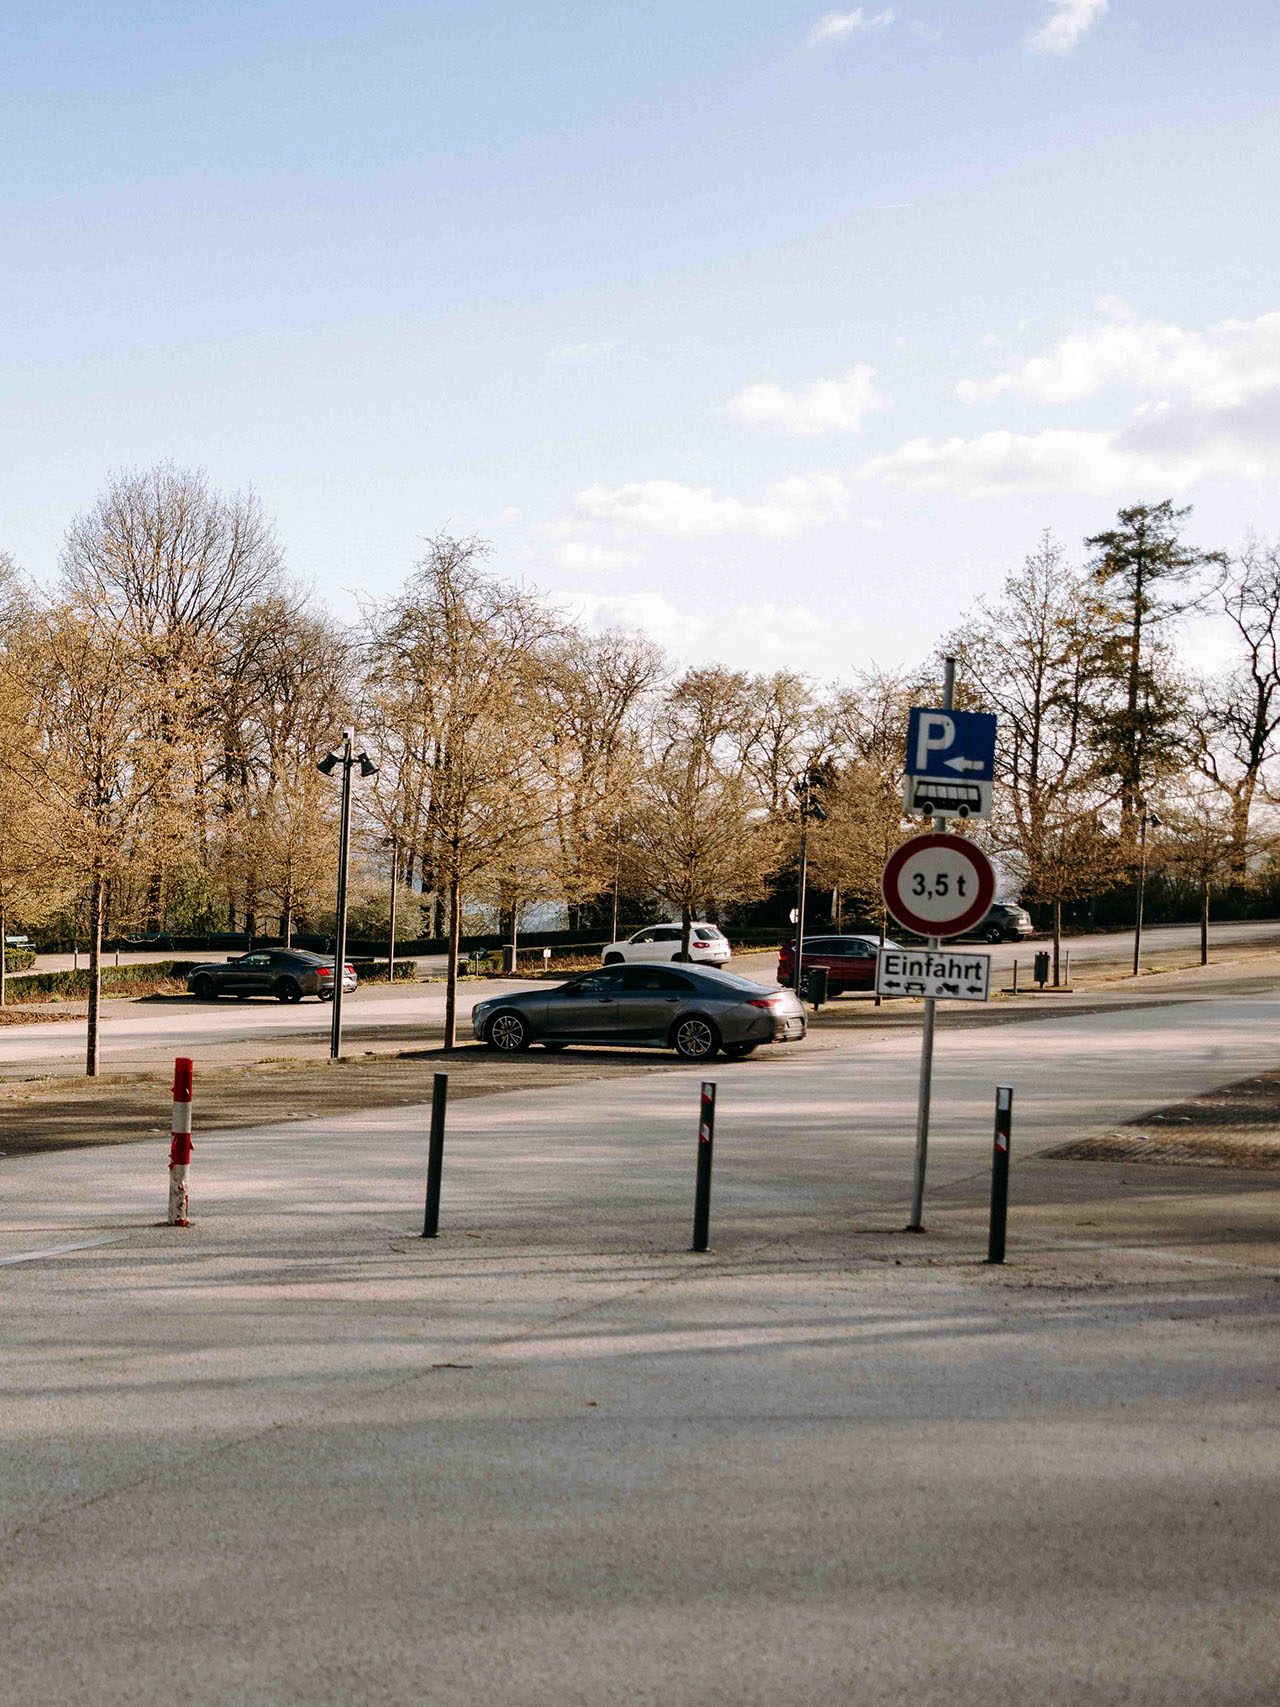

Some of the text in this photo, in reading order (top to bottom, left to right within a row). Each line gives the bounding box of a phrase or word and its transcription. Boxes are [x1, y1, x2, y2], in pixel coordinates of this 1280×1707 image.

[916, 712, 955, 770] P
[912, 873, 966, 900] 3,5 t
[885, 955, 982, 980] Einfahrt
